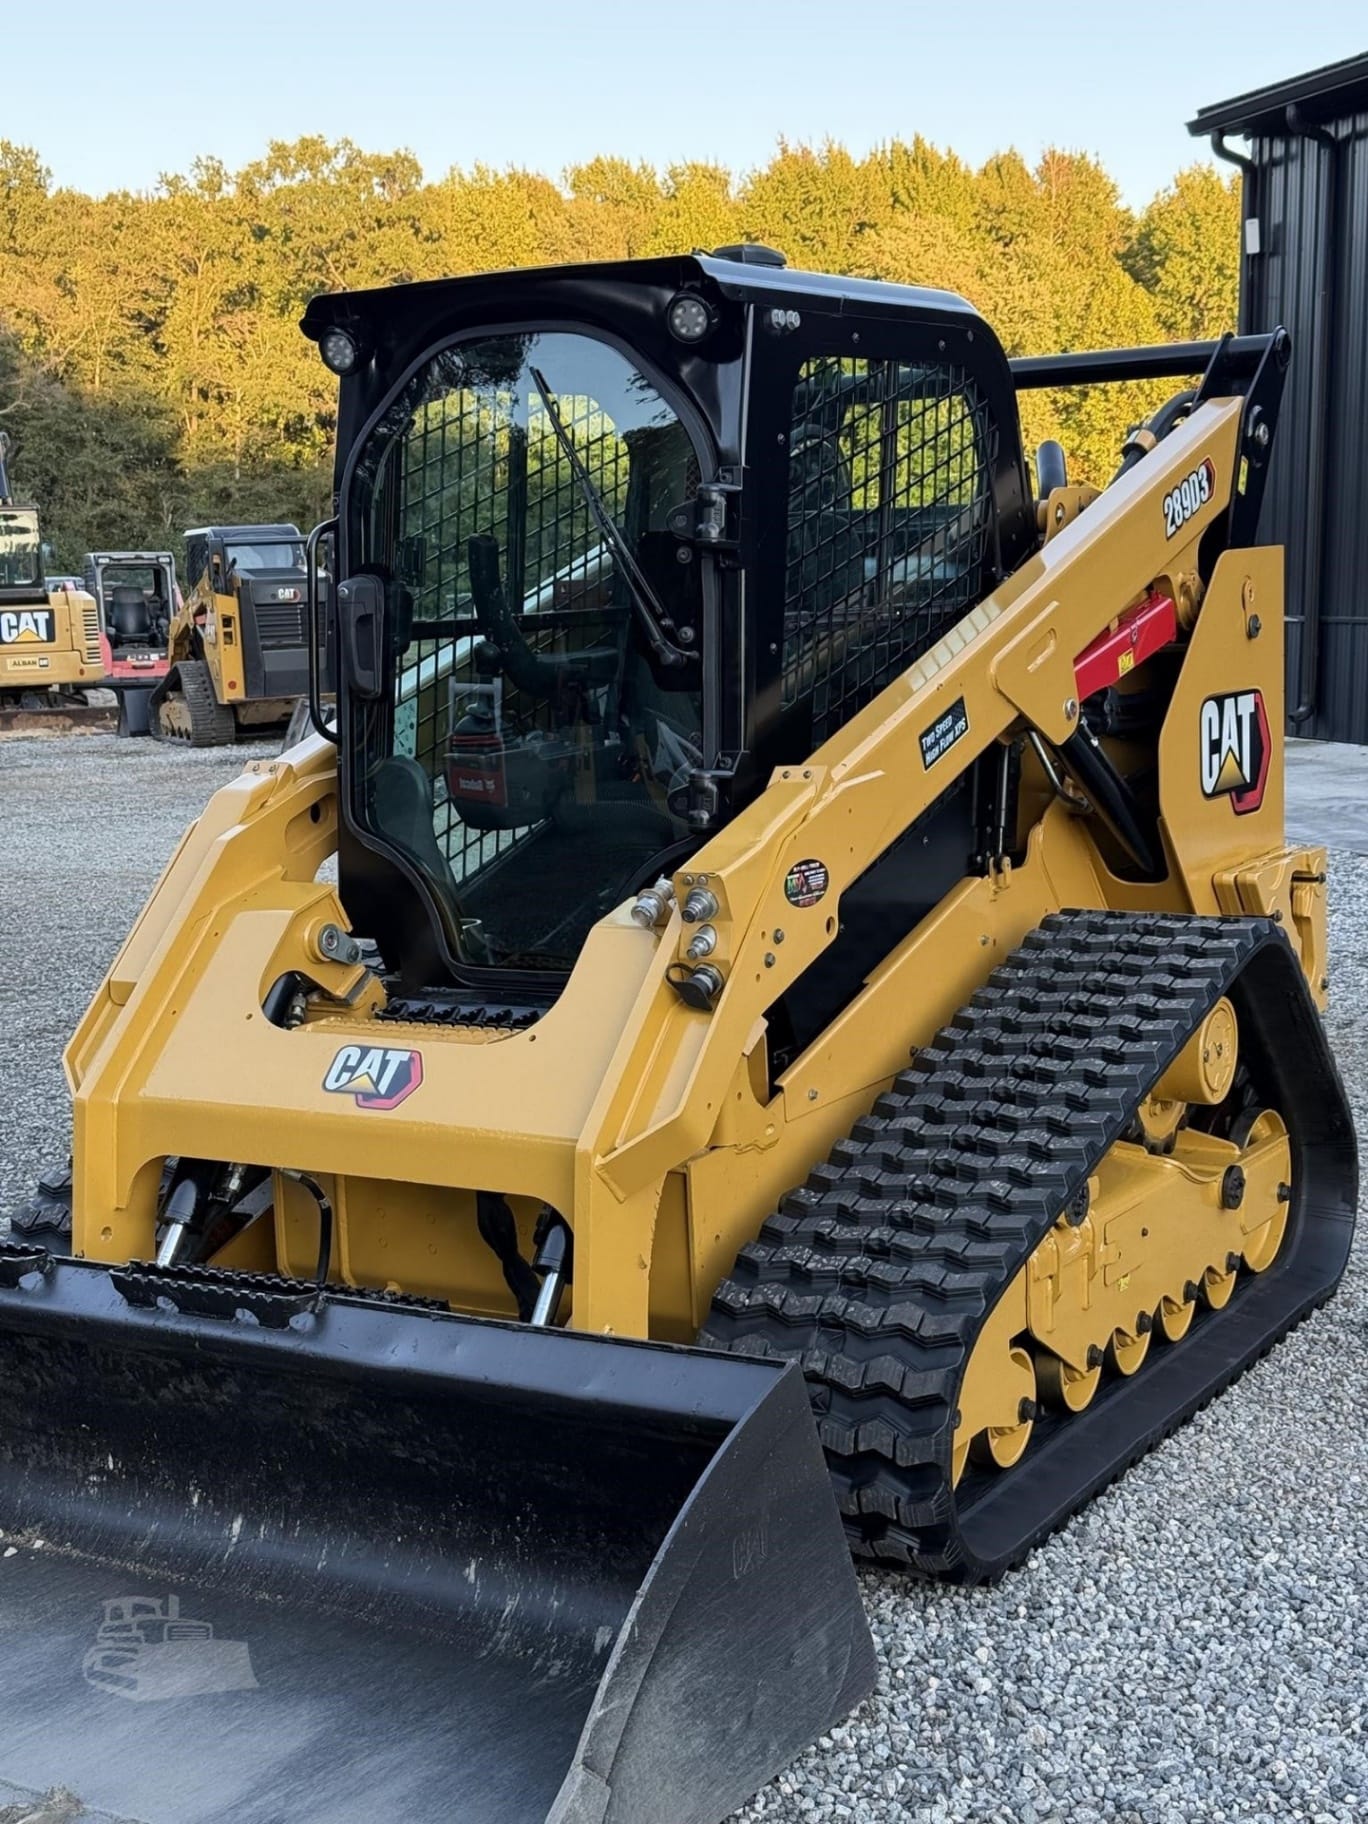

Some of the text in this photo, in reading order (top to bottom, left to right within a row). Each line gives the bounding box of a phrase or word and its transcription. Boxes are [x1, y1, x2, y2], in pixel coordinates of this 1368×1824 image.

[1164, 464, 1209, 537] 289D3
[278, 588, 296, 600] CAT
[1, 611, 49, 643] CAT
[12, 659, 37, 667] ALBAN
[1201, 693, 1255, 794] CAT
[324, 1045, 411, 1096] CAT
